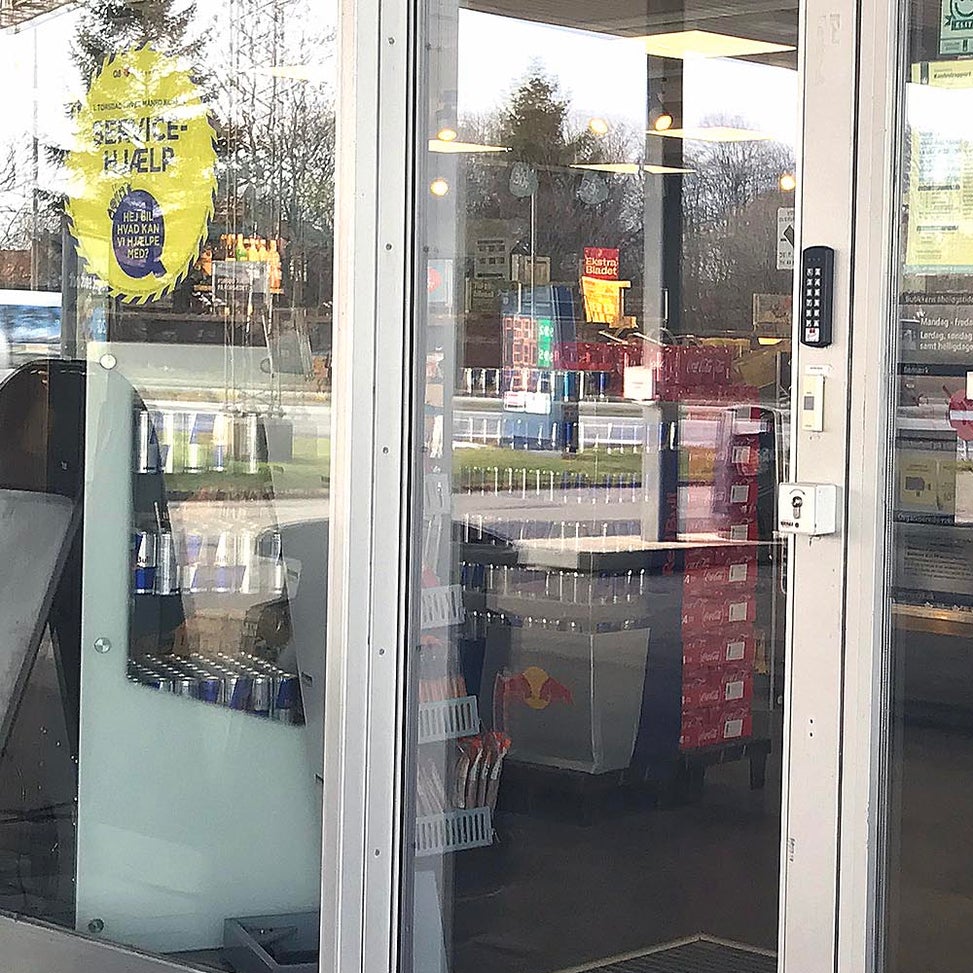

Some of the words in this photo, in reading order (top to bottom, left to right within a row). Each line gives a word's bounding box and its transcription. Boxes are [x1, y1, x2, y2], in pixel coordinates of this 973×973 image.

[123, 211, 139, 223] HEJ
[117, 223, 141, 235] HVAD
[141, 223, 160, 234] KAN
[127, 236, 160, 247] HJÆLPE
[127, 248, 149, 259] MED?
[585, 257, 617, 267] Ekstra
[585, 265, 618, 275] Bladet
[920, 317, 949, 328] Mandag
